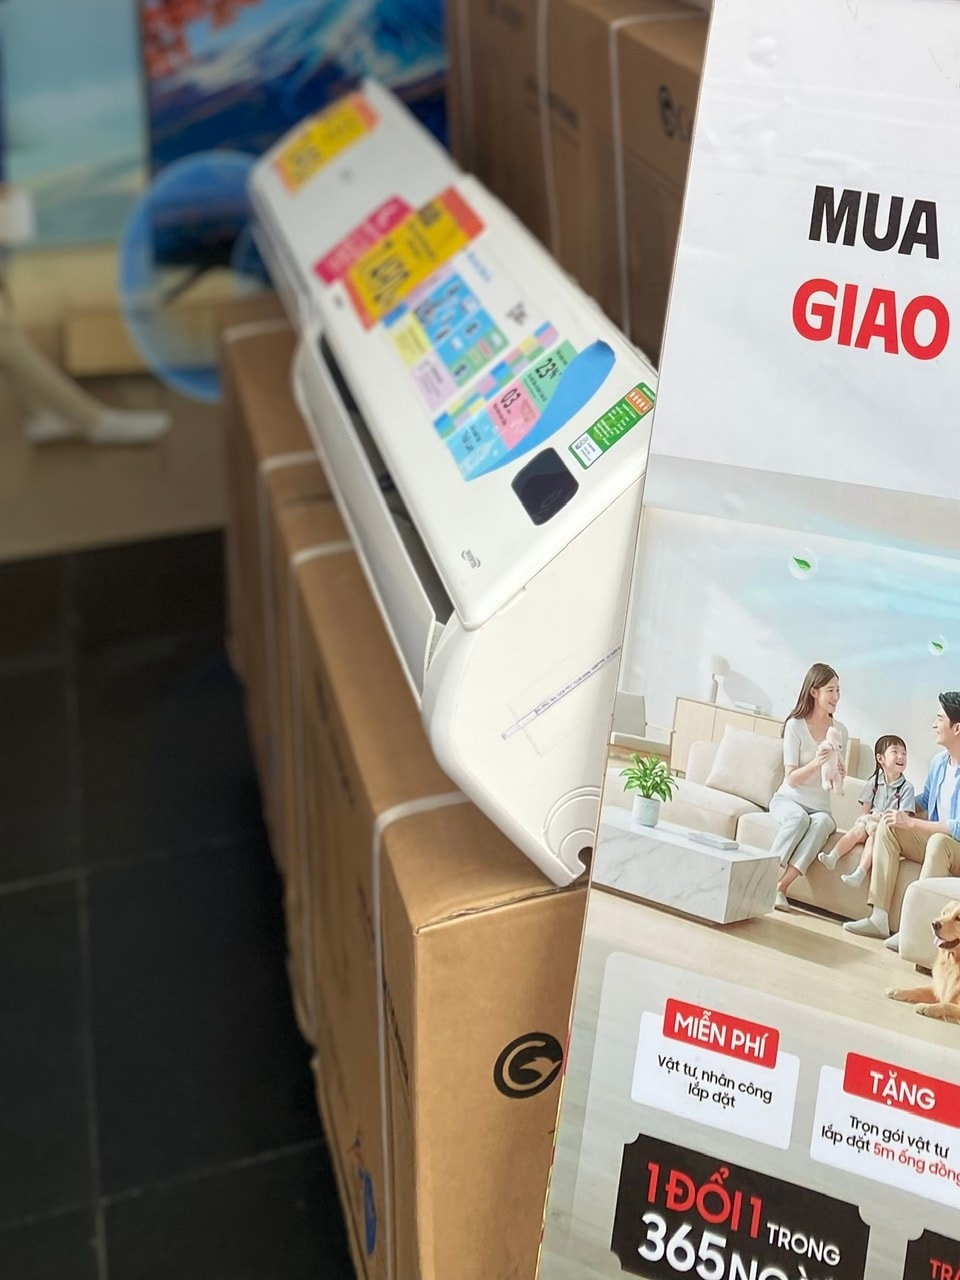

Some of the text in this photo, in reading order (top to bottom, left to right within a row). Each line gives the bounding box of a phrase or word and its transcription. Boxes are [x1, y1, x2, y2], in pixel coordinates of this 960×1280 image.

[808, 185, 940, 260] MUA
[791, 278, 951, 361] GIAO
[673, 1007, 770, 1059] MIỄN PHÍ
[657, 1054, 680, 1074] Vật
[700, 1067, 736, 1092] nhân
[737, 1078, 774, 1105] công
[688, 1081, 736, 1110] lắp đặt
[869, 1070, 936, 1112] TẶNG
[820, 1124, 843, 1148] lắp
[845, 1129, 870, 1154] đặt
[872, 1141, 898, 1162] 5m
[898, 1148, 926, 1174] ống
[849, 1114, 950, 1159] Trọn gói vật tư
[646, 1162, 763, 1239] 1 ĐỔI 1
[766, 1221, 841, 1267] TRONG
